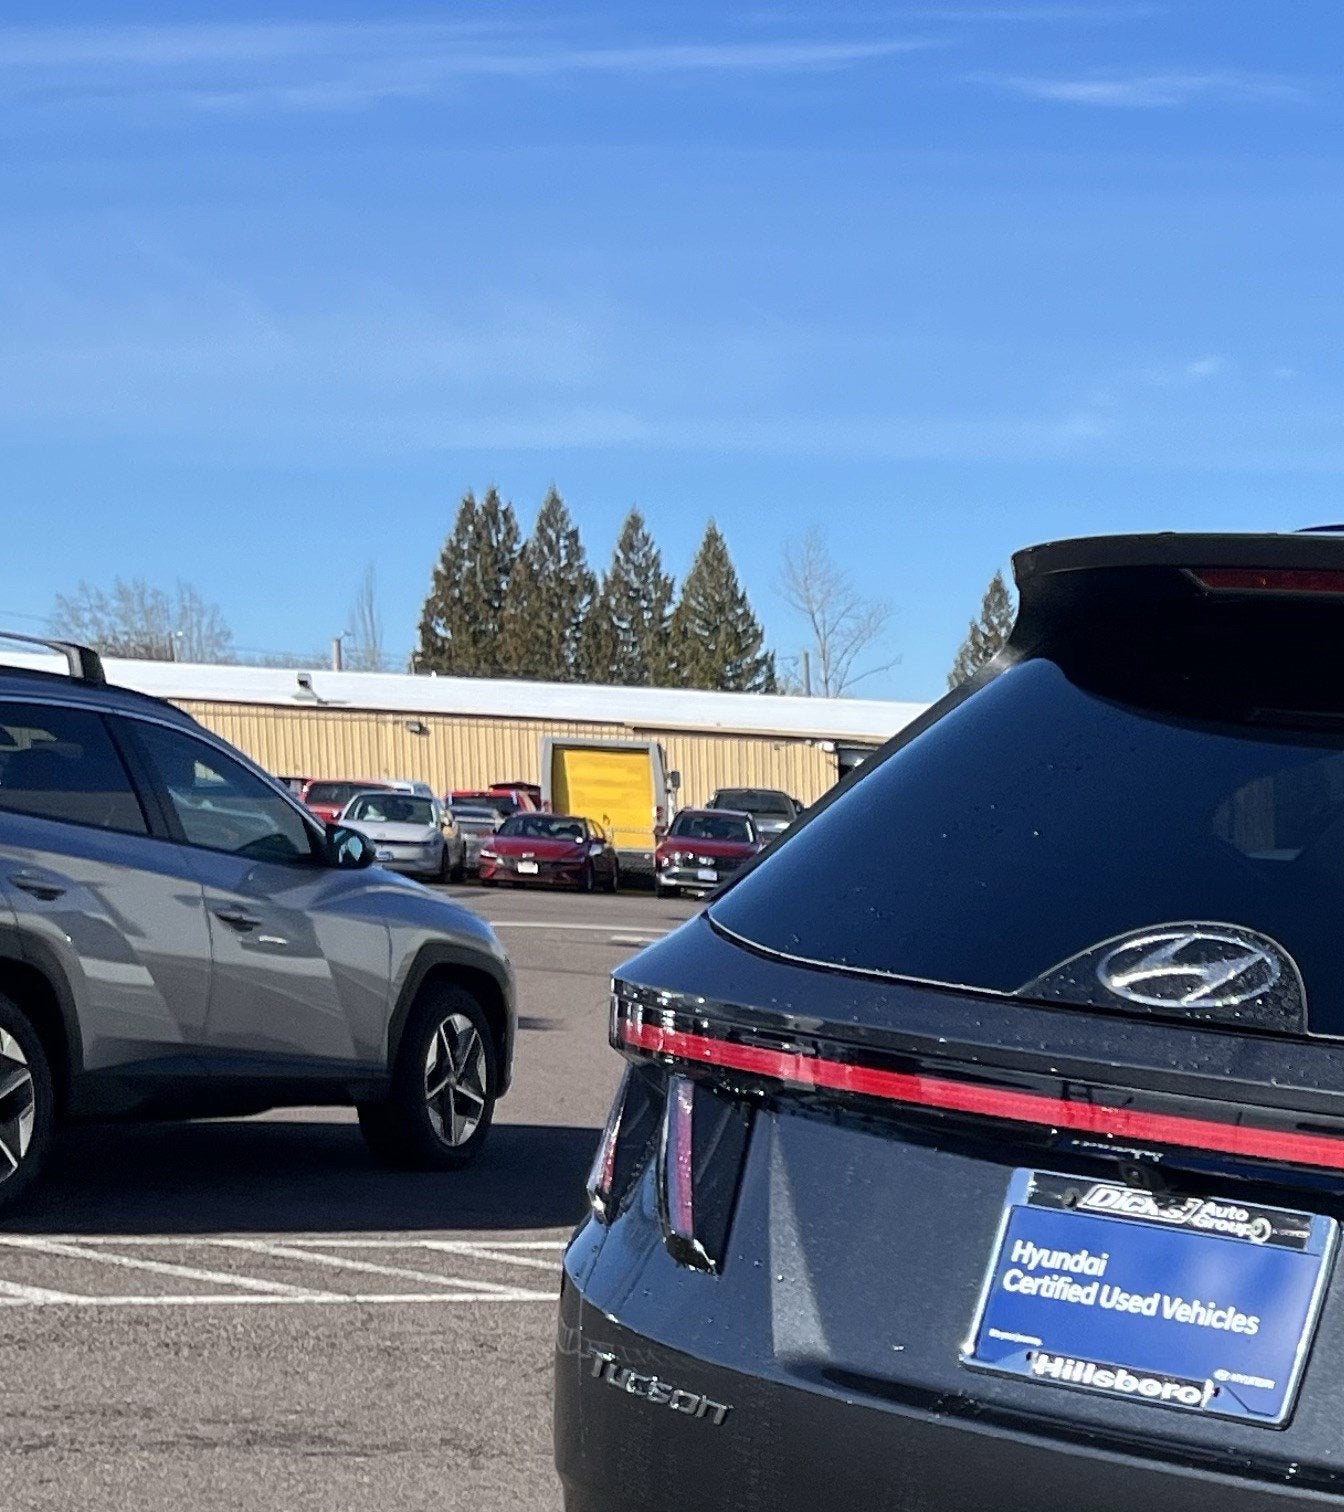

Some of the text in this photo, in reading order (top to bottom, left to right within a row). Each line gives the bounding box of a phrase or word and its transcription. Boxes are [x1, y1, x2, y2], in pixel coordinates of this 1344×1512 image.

[1200, 1201, 1249, 1221] Auto
[1011, 1239, 1109, 1277] Hyundai
[1002, 1268, 1261, 1335] Certified Used Vehicles
[589, 1349, 727, 1425] Tucson
[1032, 1353, 1203, 1405] Hillsboro
